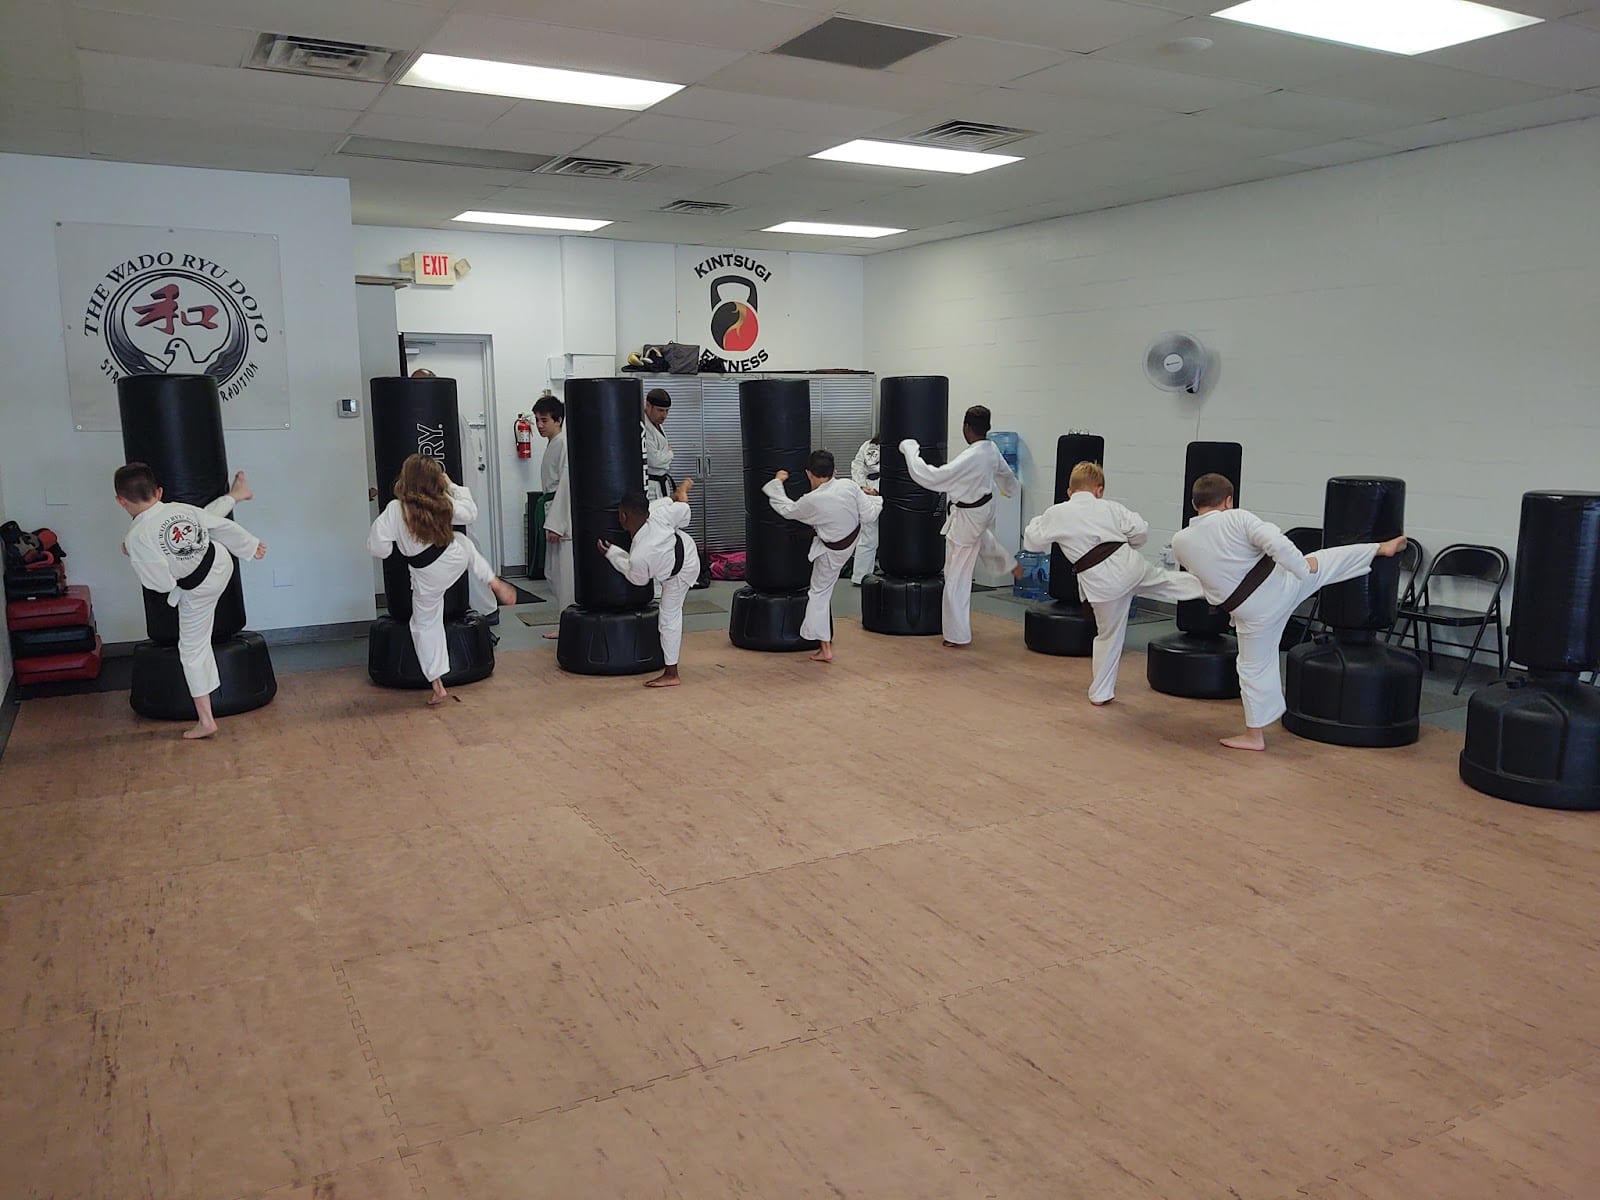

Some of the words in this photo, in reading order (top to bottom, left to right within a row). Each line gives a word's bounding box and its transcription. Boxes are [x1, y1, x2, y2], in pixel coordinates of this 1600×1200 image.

[422, 255, 449, 276] EXIT
[693, 253, 772, 283] KINTSUGI
[84, 284, 109, 337] THE
[106, 251, 174, 284] WADO
[181, 253, 229, 280] RYU
[227, 278, 269, 344] DOJO
[132, 284, 219, 335] 和
[700, 347, 769, 372] FNESS
[100, 358, 119, 384] STR
[220, 361, 259, 402] RADITION
